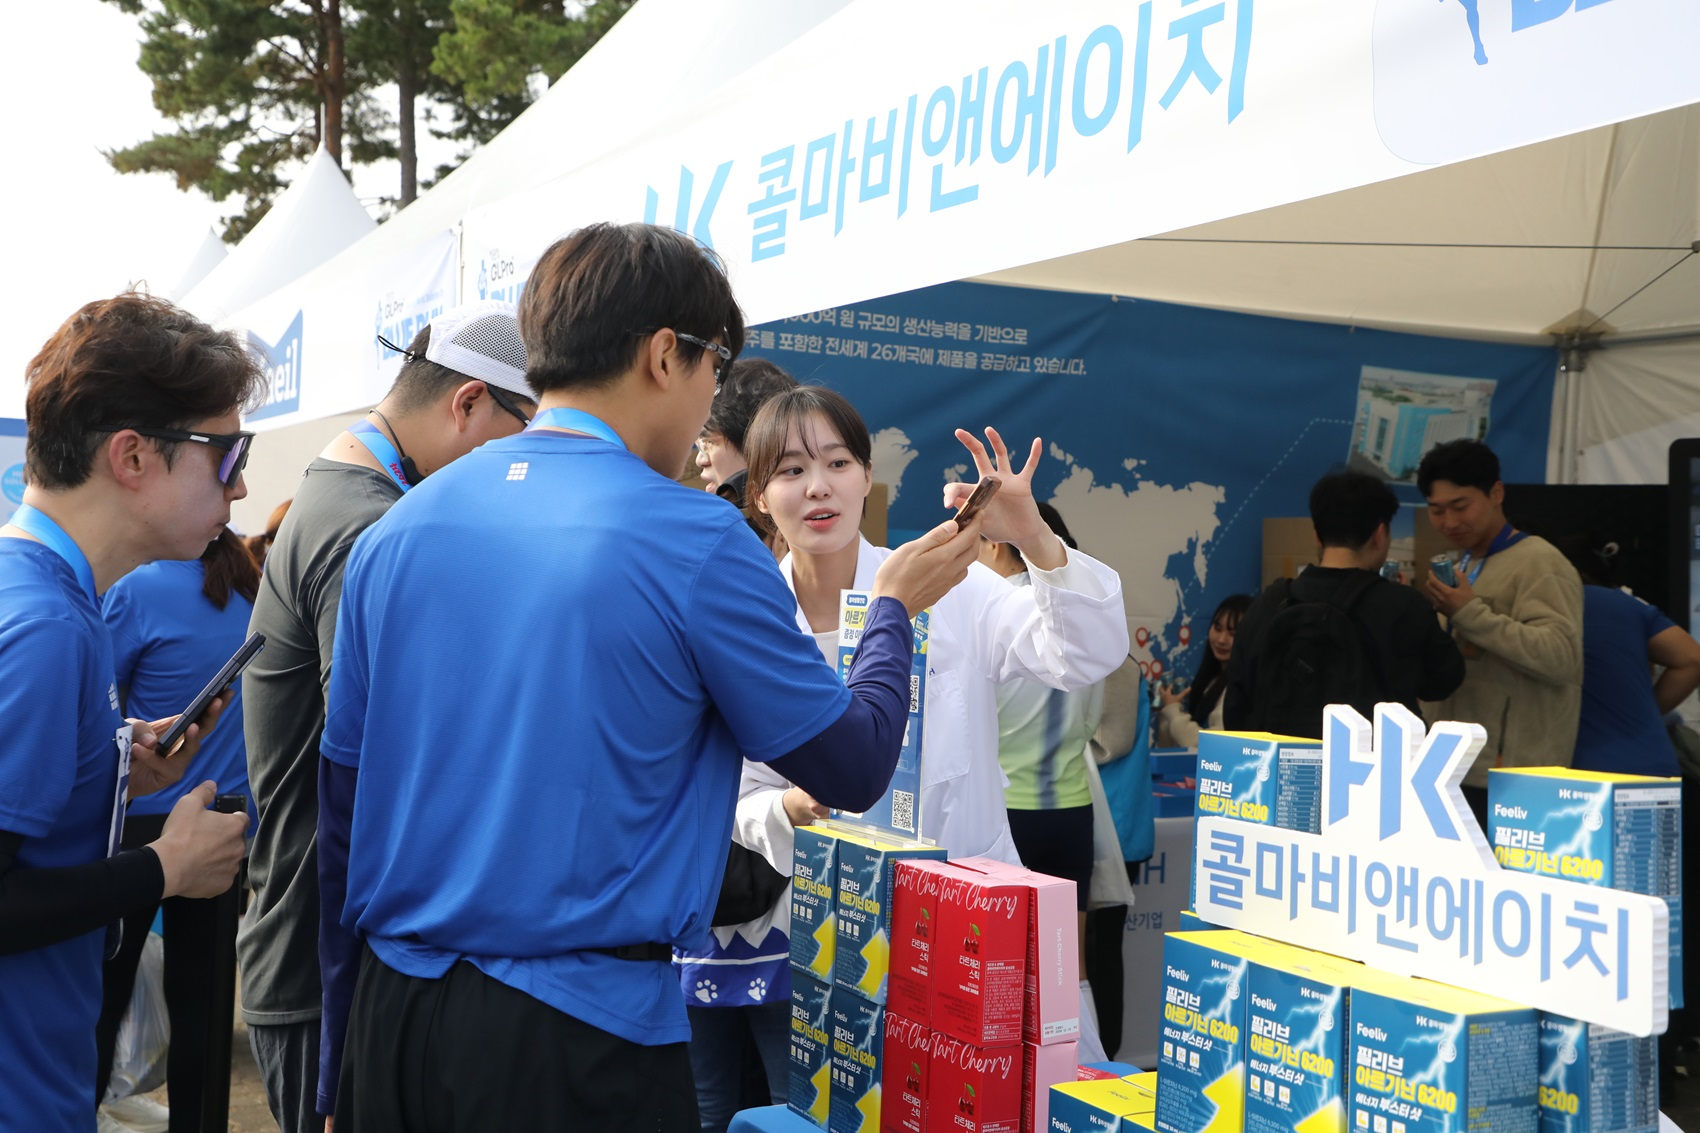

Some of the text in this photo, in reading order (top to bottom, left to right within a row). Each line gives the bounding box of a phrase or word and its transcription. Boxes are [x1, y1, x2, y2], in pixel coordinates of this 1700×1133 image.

[747, 0, 1254, 263] 콜마비앤에이치
[839, 309, 854, 328] 원
[857, 311, 900, 333] 규모의
[903, 317, 972, 341] 생산능력을
[974, 324, 1028, 345] 기반으로
[778, 332, 823, 354] 포함한
[825, 336, 868, 359] 전세계
[871, 343, 934, 366] 26개국에
[936, 348, 978, 369] 제품을
[980, 352, 1031, 373] 공급하고
[1033, 356, 1087, 375] 있습니다.
[1200, 759, 1223, 773] Feeliv
[1328, 712, 1463, 842] HK
[1199, 778, 1233, 798] 필리브
[1198, 794, 1269, 822] 아르기닌 6200
[1494, 804, 1528, 820] Feeliv
[1494, 826, 1546, 851] 필리브
[1494, 846, 1604, 880] 아르기닌 6200
[966, 881, 1018, 919] Cherry
[1202, 829, 1630, 1003] 콜마비앤에이치
[1166, 965, 1190, 982] Feeliv
[1165, 985, 1201, 1012] 필리브
[1251, 994, 1277, 1011] Feeliv
[1164, 1003, 1239, 1045] 아르기닌 6200
[1251, 1015, 1290, 1043] 필리브
[1356, 1022, 1387, 1042] Feeliv
[859, 1048, 876, 1069] 6200
[960, 1044, 1012, 1080] Cherry
[1250, 1034, 1334, 1078] 아르기닌 6200
[1356, 1045, 1404, 1076] 필리브
[1355, 1066, 1457, 1113] 아르기닌 6200
[1539, 1085, 1579, 1115] 6200
